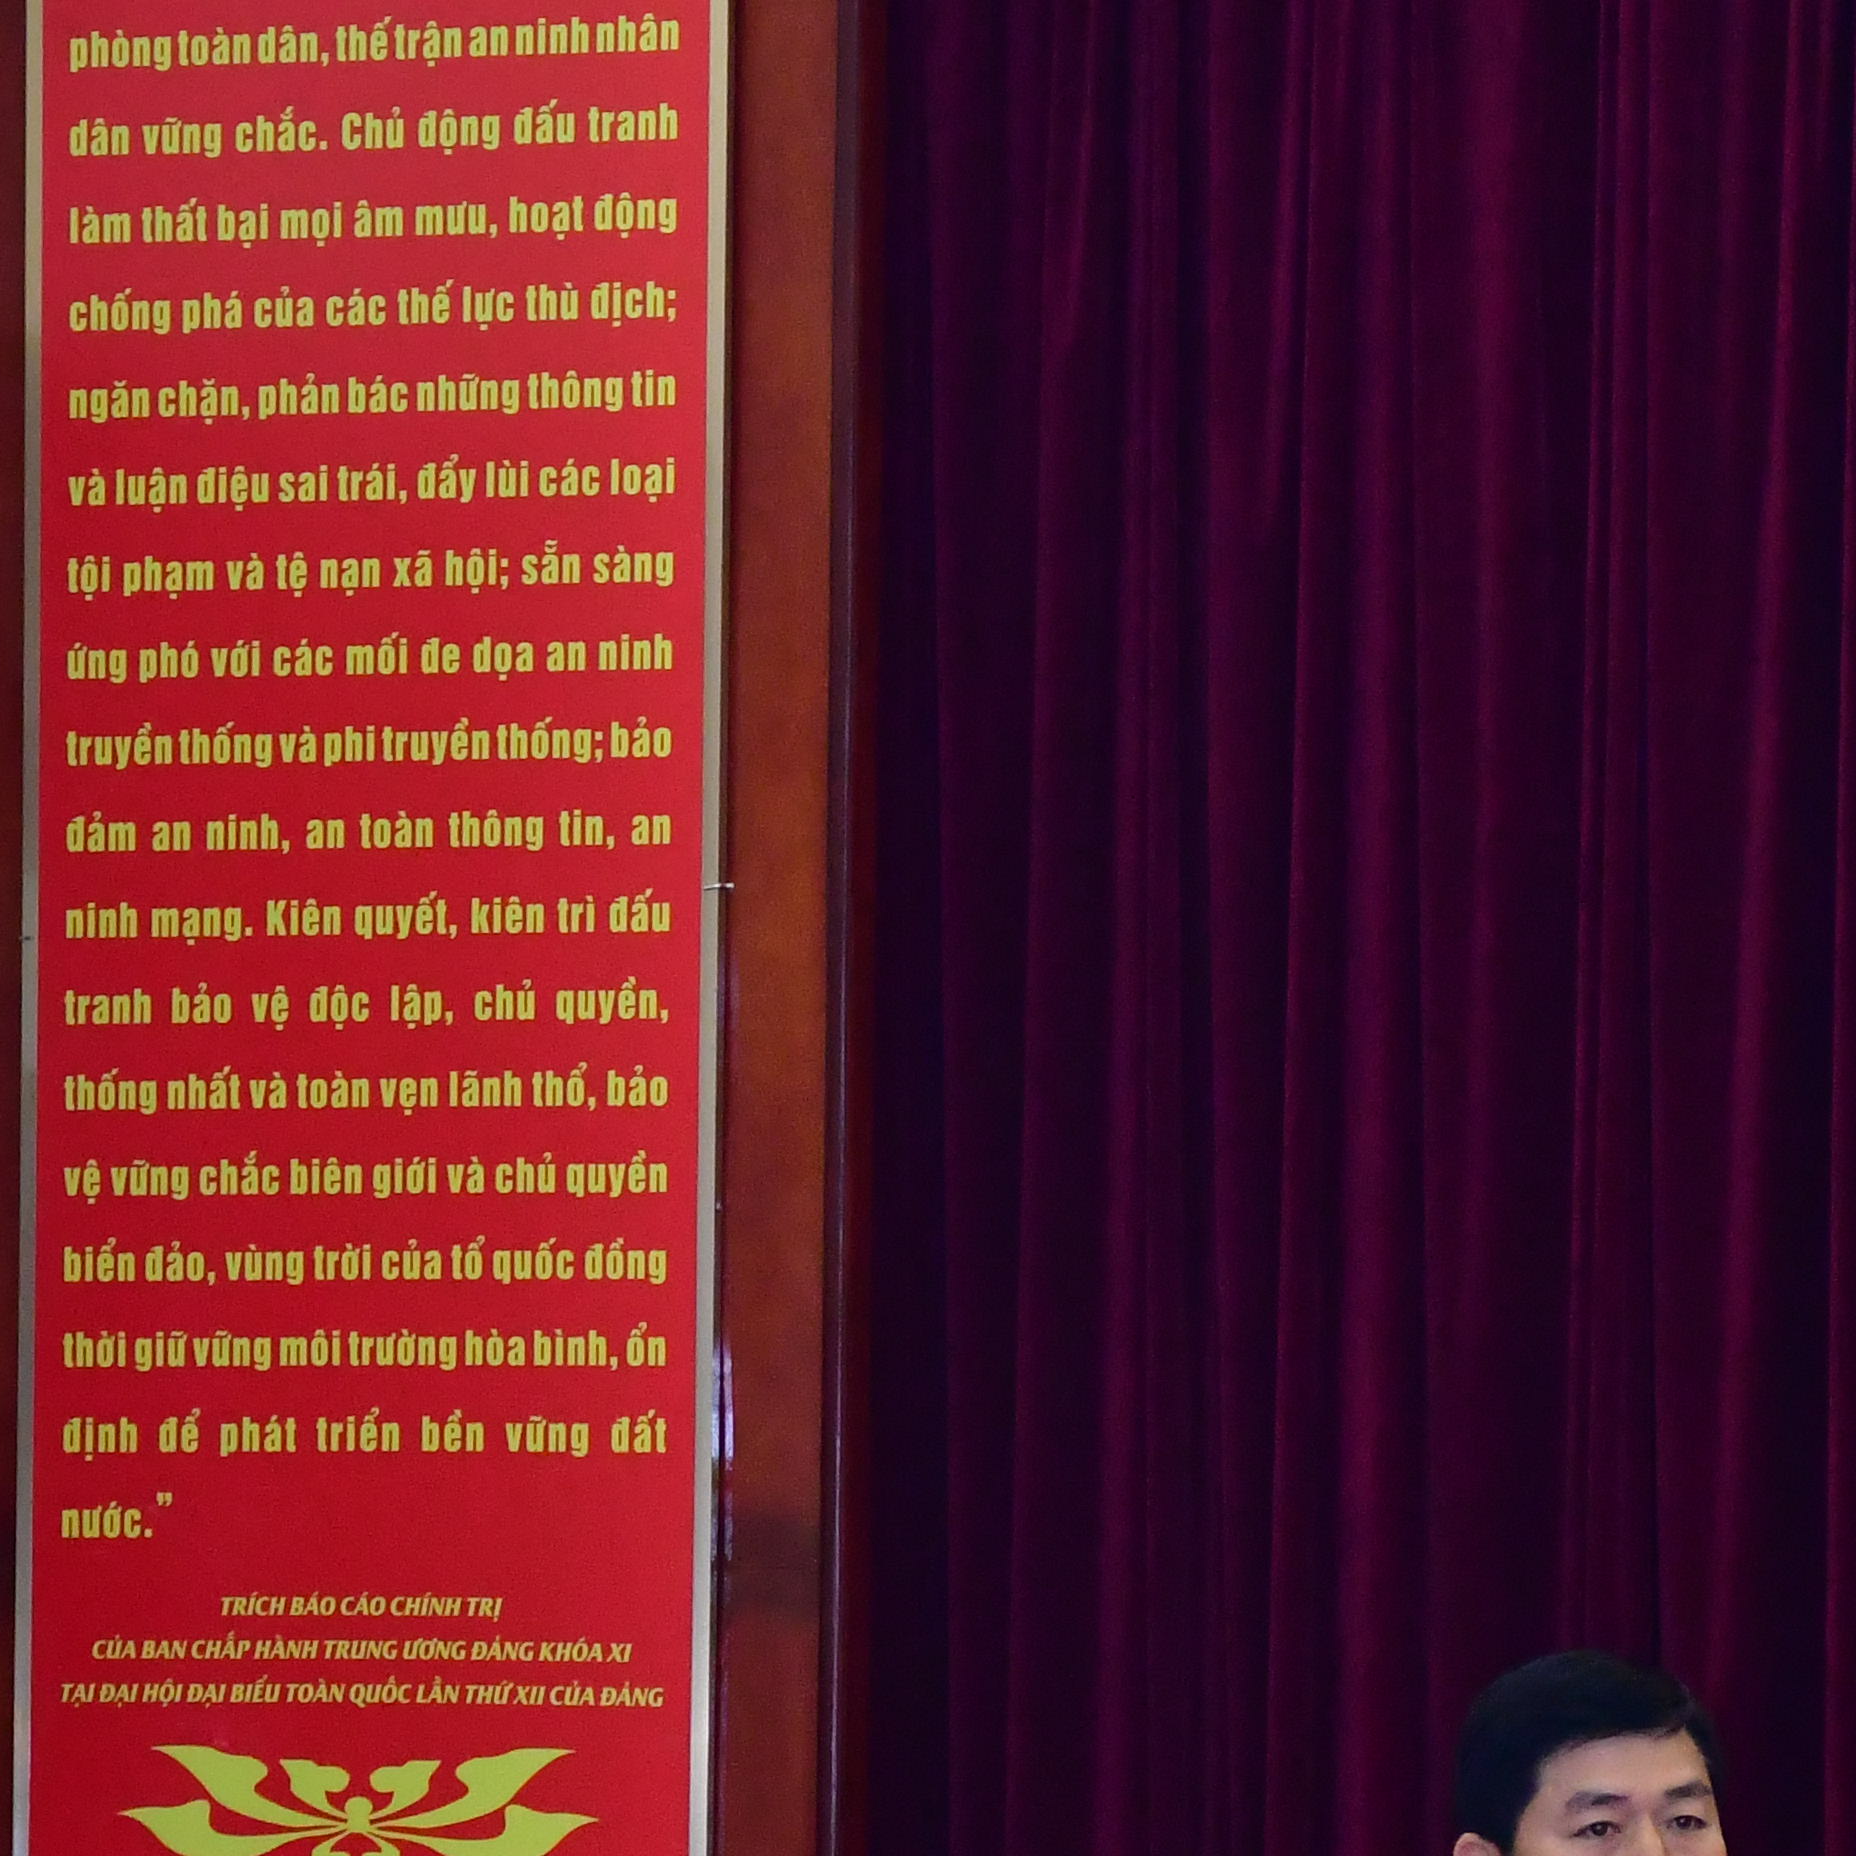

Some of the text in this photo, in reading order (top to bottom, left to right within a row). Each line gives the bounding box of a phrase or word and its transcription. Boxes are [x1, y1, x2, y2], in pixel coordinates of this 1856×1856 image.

[69, 12, 681, 73] phòng toàn dân, thế trận an ninh nhân
[69, 98, 679, 159] dân vững chắc. Chủ động đấu tranh
[69, 191, 678, 249] làm thất bại mọi âm mưu, hoạt động
[69, 278, 677, 335] chống phá của các thế lực thù địch;
[69, 368, 677, 425] ngăn chặn, phản bác những thông tin
[68, 453, 676, 513] và luận điệu sai trái, đẩy lùi các loại
[67, 539, 675, 601] tội phạm và tệ nạn xã hội; sẵn sàng
[66, 808, 672, 855] đảm an ninh, an toàn thông tin, an
[65, 887, 671, 946] ninh mạng. Kiên quyết, kiên trì đấu
[64, 975, 669, 1031] tranh bảo vệ độc lập, chủ quyền,
[64, 1061, 669, 1116] thống nhất và toàn vẹn lãnh thổ, bảo
[63, 1149, 668, 1205] vệ vững chắc biên giới và chủ quyền
[63, 1234, 667, 1286] biển đảo, vùng trời của tổ quốc đồng
[62, 1407, 667, 1461] định để phát triển bền vững đất
[221, 1591, 503, 1623] TRÍCH BÁO CÁO CHÍNH TRỊ
[92, 1631, 633, 1663] CỦA BAN CHẤP HÀNH TRUNG ƯƠNG ĐẢNG KHÓA XI
[61, 1674, 664, 1708] TẠI ĐẠI HỘI ĐẠI BIỂU TOÀN QUỐC LẦN THỨ XII CỦA ĐẢNG
